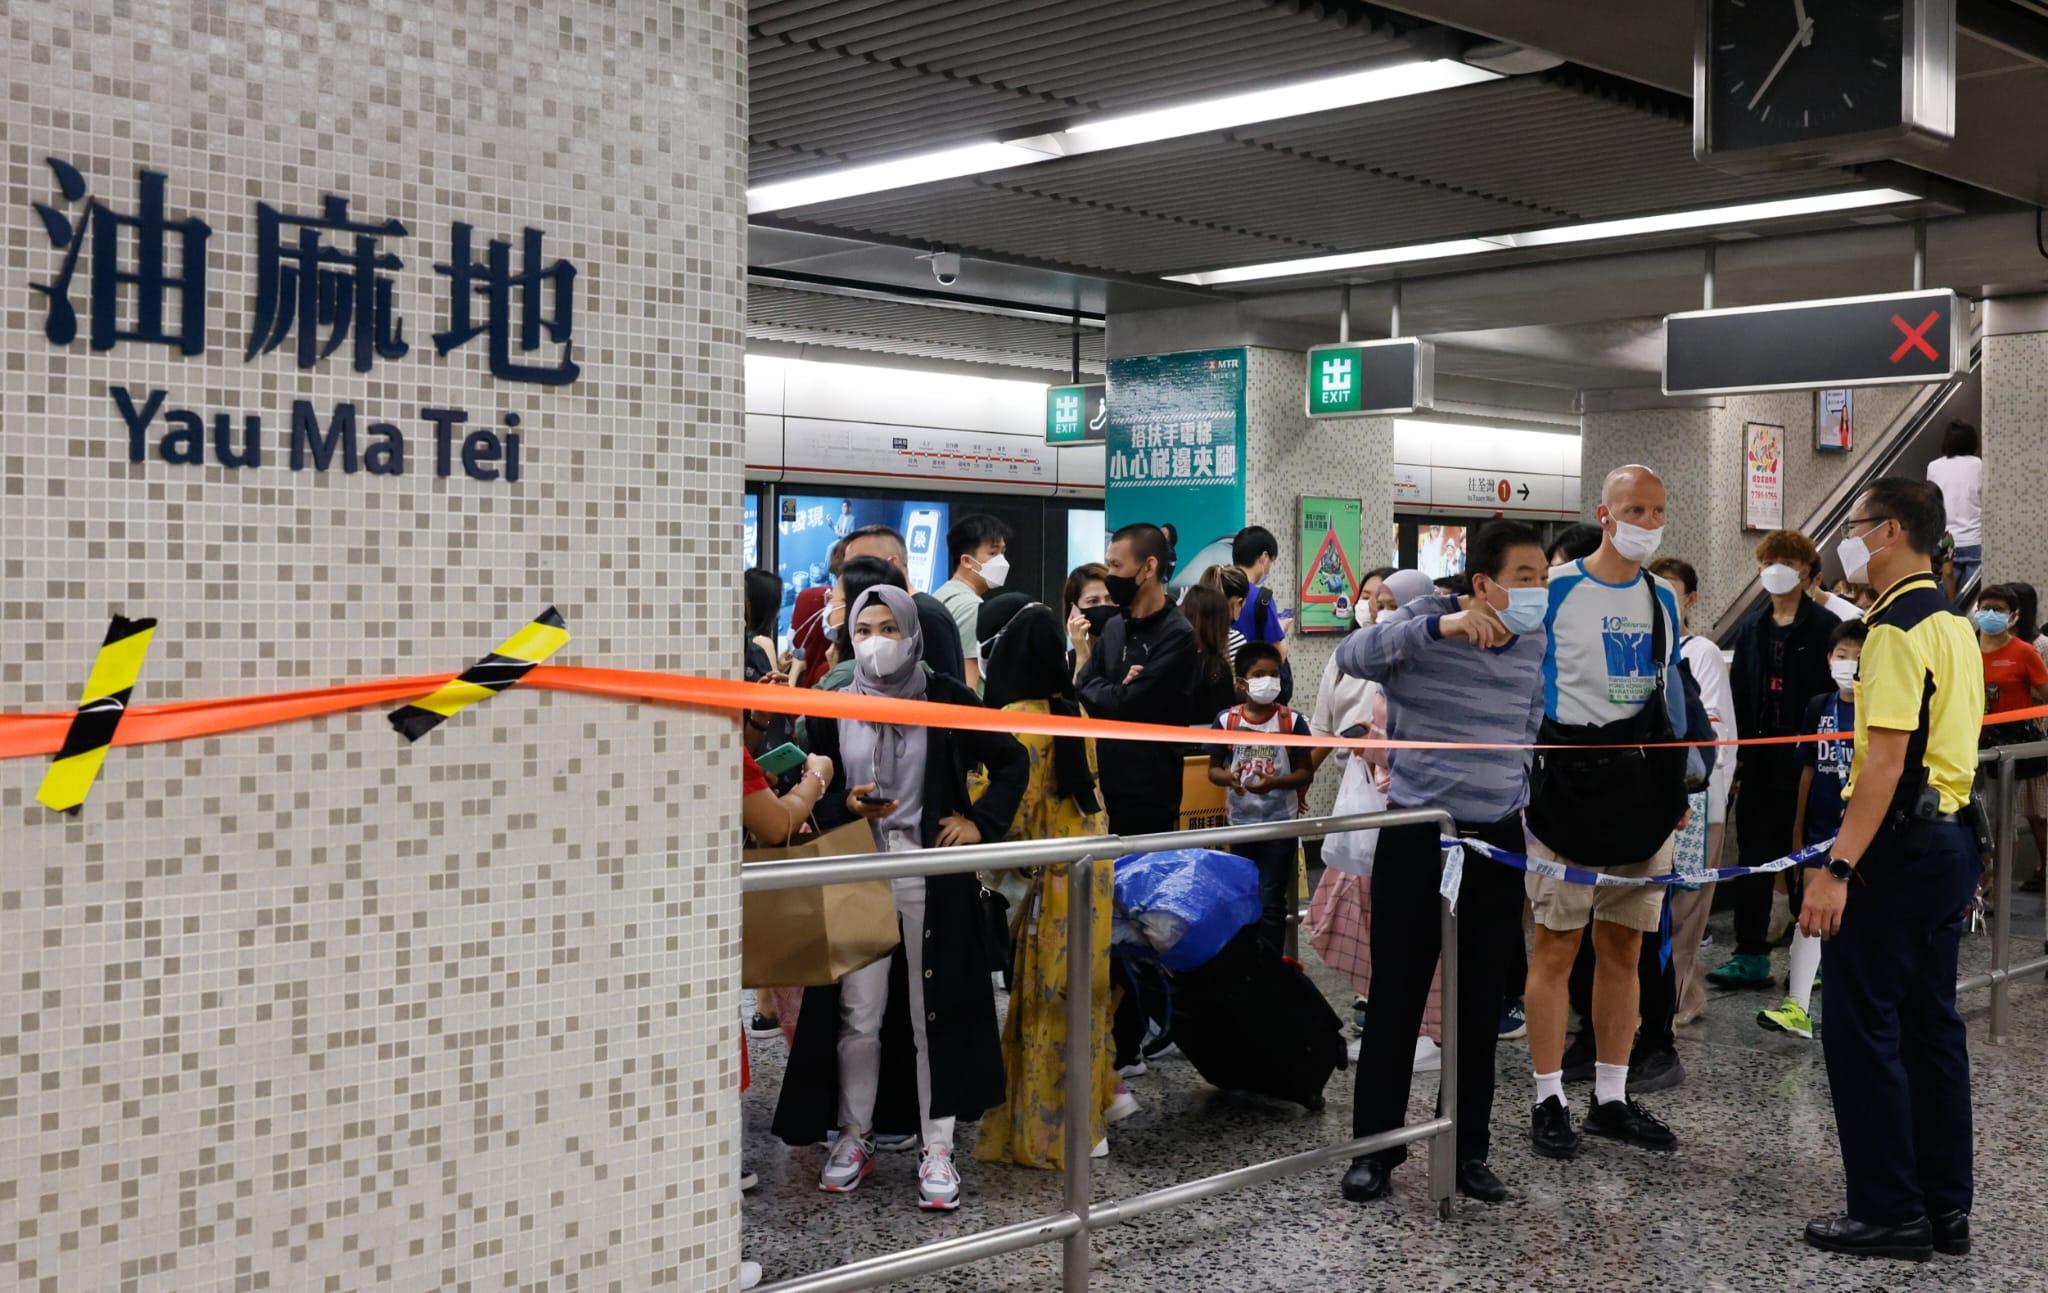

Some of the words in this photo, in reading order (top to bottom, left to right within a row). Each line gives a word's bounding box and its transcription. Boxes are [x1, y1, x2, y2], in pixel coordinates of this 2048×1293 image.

[29, 156, 580, 385] 油麻地
[1217, 359, 1239, 369] MTR
[1322, 358, 1351, 391] 出
[1055, 395, 1079, 423] 出
[1322, 390, 1351, 404] EXIT
[110, 386, 261, 468] Yau
[290, 400, 404, 476] Ma
[421, 407, 521, 483] Tei
[1055, 422, 1078, 434] EXIT
[1131, 420, 1213, 448] 搭扶手電梯
